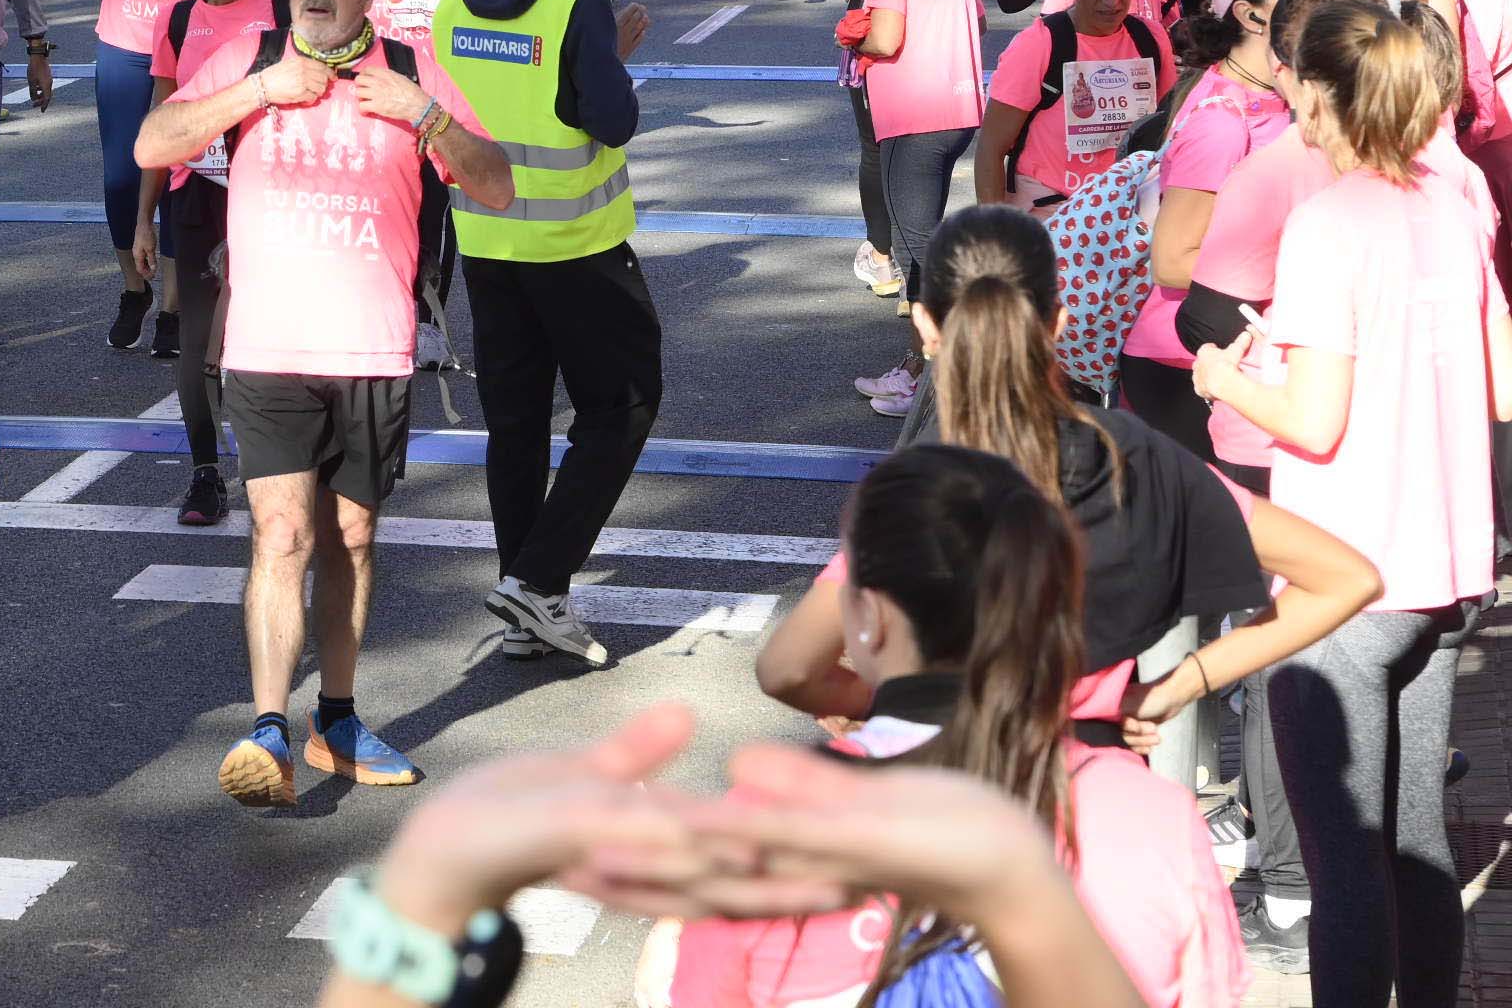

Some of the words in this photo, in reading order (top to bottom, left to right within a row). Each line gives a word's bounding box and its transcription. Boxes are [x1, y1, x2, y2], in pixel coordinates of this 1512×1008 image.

[453, 33, 530, 57] VOLUNTARIS
[1097, 95, 1128, 109] 016
[1102, 112, 1127, 122] 28838
[295, 191, 382, 215] DORSAL
